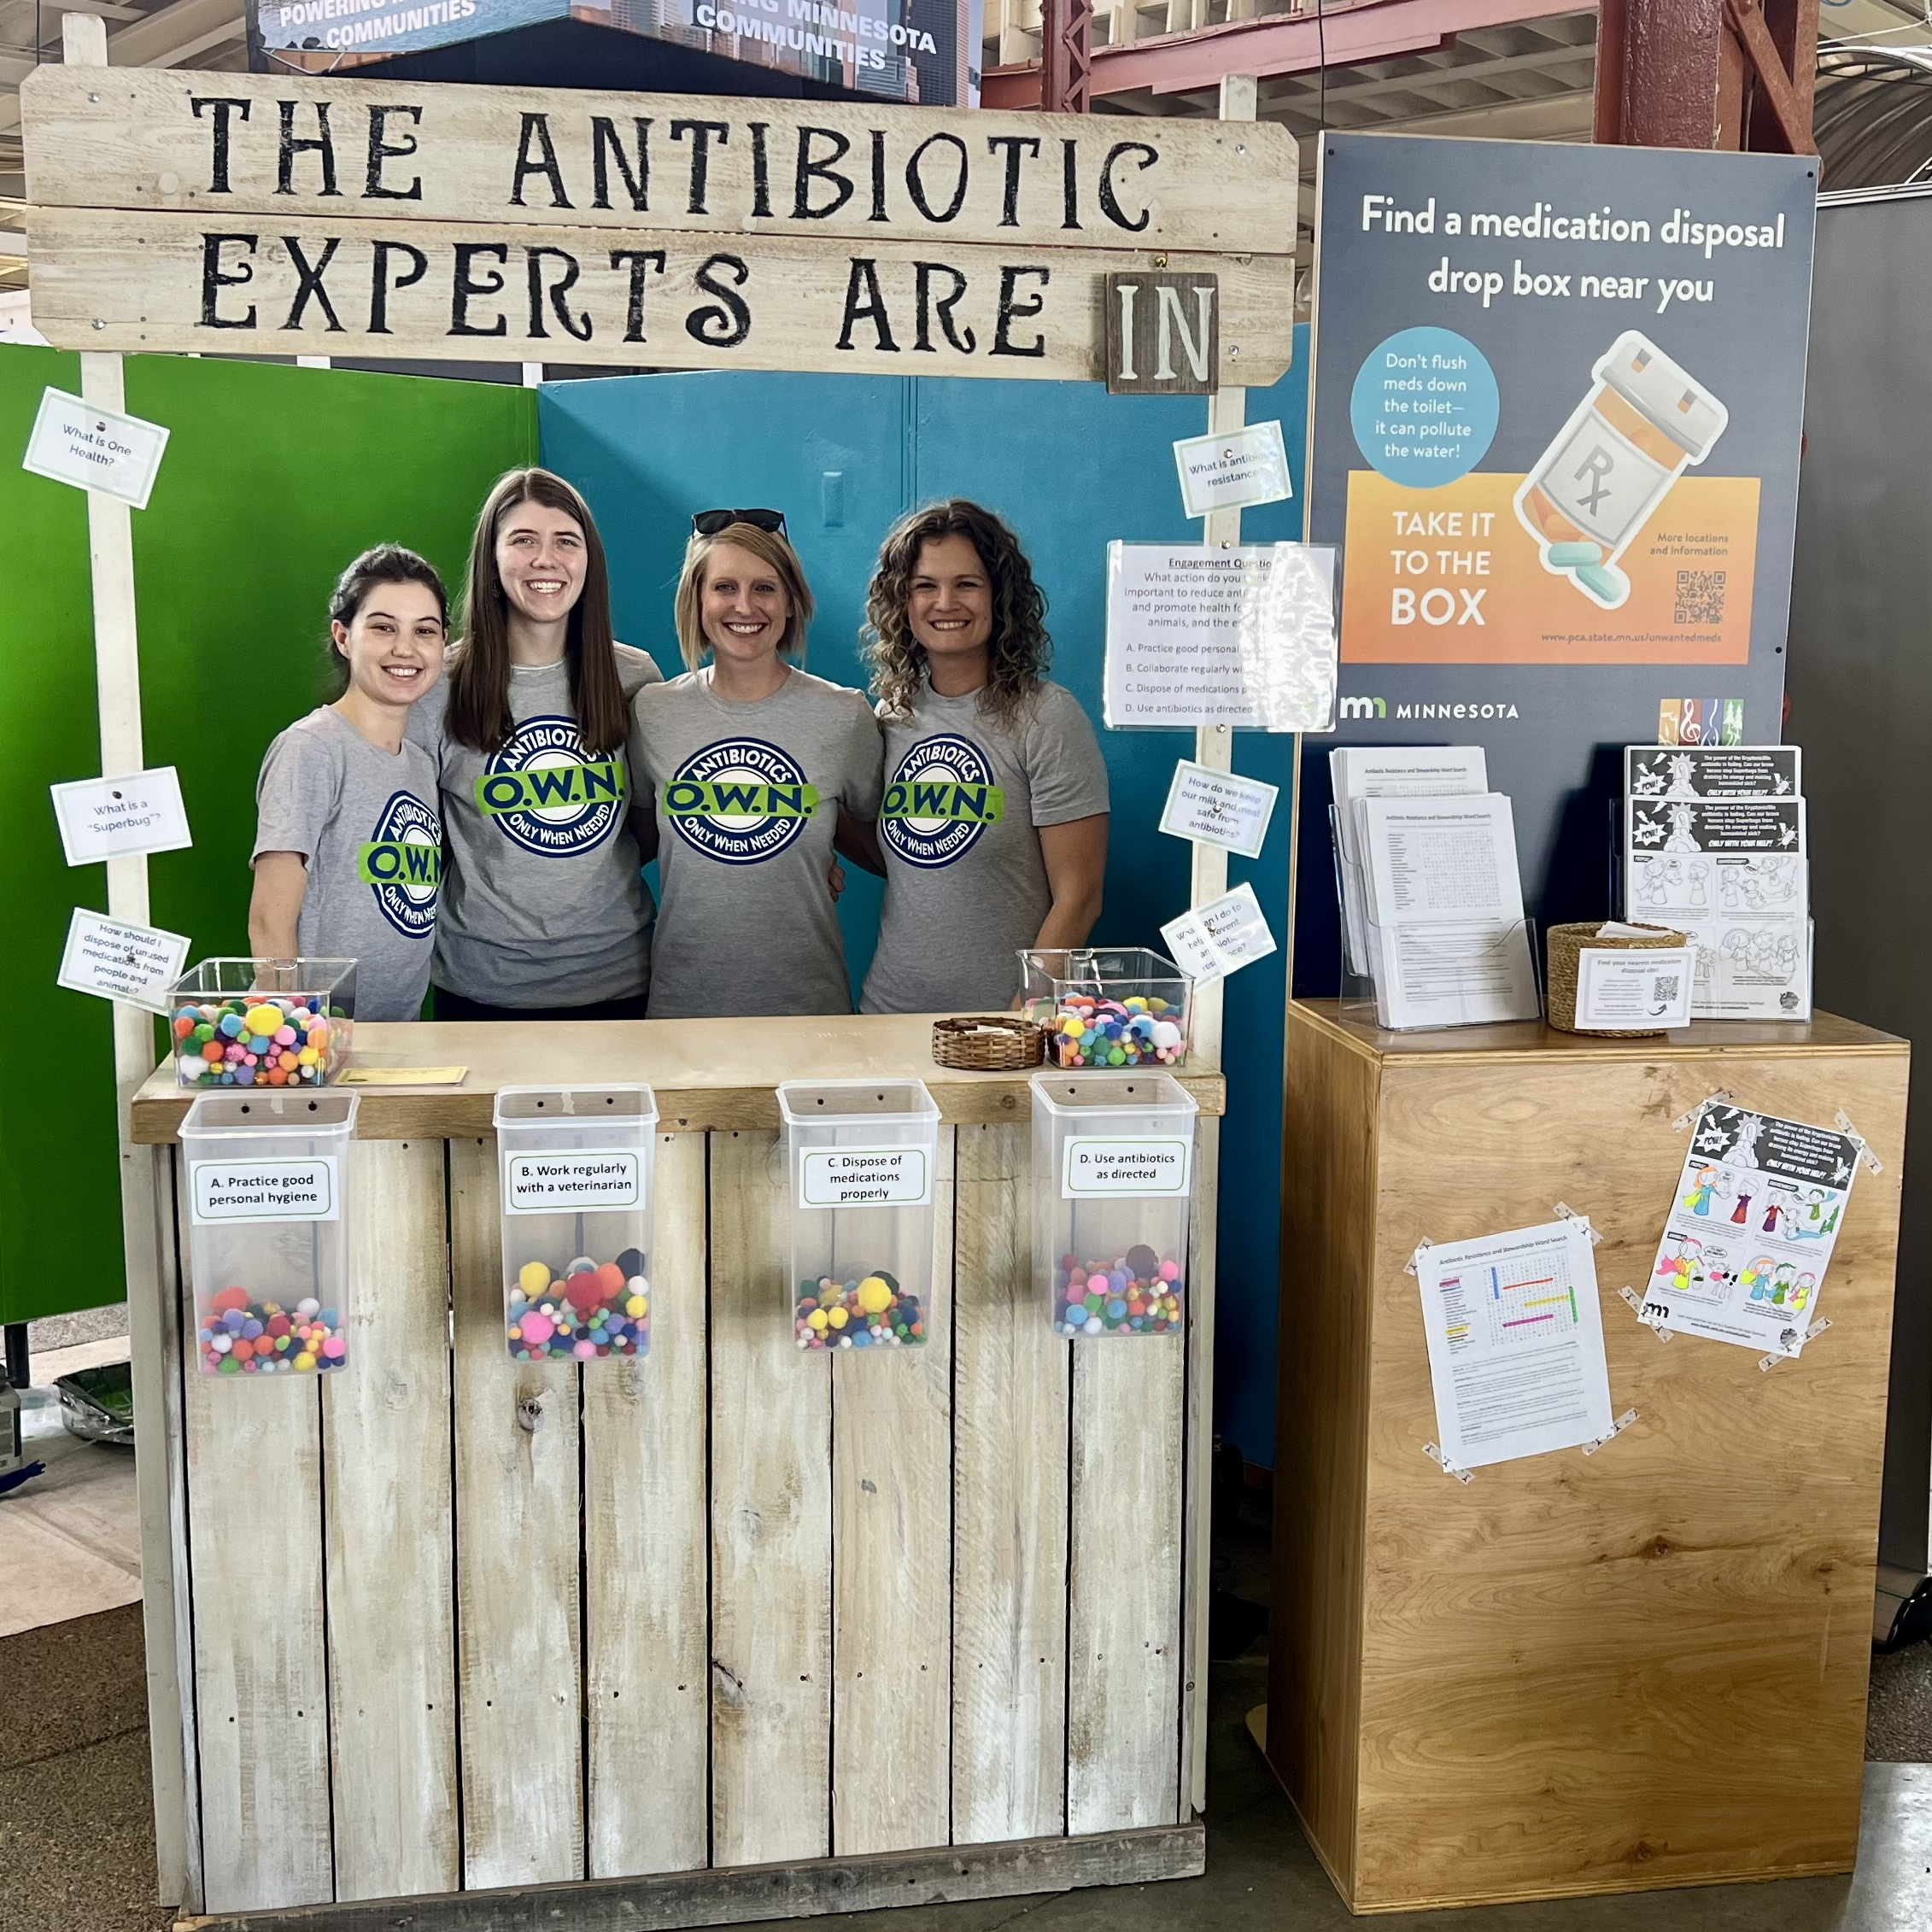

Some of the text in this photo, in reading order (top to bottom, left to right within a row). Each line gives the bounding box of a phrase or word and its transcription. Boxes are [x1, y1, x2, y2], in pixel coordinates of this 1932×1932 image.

[326, 0, 476, 49] COMMUNITIES
[787, 0, 936, 54] MINNESOTA
[696, 4, 886, 70] COMMUNITIES
[190, 97, 1159, 231] THE ANTIBIOTIC
[1362, 195, 1785, 259] Find a medication disposal
[1428, 256, 1714, 313] drop box near you
[195, 232, 1215, 381] EXPERTS ARE IN
[1386, 353, 1467, 370] Don't flush
[1384, 376, 1467, 392] meds down
[1385, 398, 1409, 413] the
[1375, 420, 1472, 439] it can pollute
[62, 424, 132, 456] What is One
[69, 444, 115, 467] Health?
[1385, 442, 1461, 458] the water!
[1189, 461, 1218, 475] What
[1219, 459, 1228, 469] is
[1392, 511, 1495, 536] TAKE IT
[1657, 532, 1729, 543] More locations
[1650, 546, 1728, 556] and information
[1168, 558, 1231, 569] Engagement
[1390, 550, 1491, 575] TO THE
[1144, 572, 1171, 583] What
[1174, 572, 1205, 583] action
[1208, 572, 1221, 583] do
[1223, 575, 1241, 585] you
[1124, 588, 1174, 599] important
[1177, 588, 1188, 598] to
[1191, 587, 1224, 598] reduce
[1132, 603, 1150, 612] and
[1153, 603, 1196, 613] promote
[1199, 602, 1231, 612] health
[1390, 588, 1487, 626] BOX
[1147, 618, 1189, 629] animals,
[1191, 618, 1210, 628] and
[1213, 618, 1230, 628] the
[1541, 632, 1722, 645] www.pca.state.mn.us/unwantedmeds
[1126, 643, 1239, 655] A. Practice good personal
[1126, 664, 1134, 673] B.
[1137, 664, 1189, 673] Collaborate
[1191, 664, 1230, 675] regularly
[1125, 683, 1134, 693] C.
[1136, 683, 1172, 694] Dispose
[1174, 683, 1184, 693] of
[1186, 684, 1239, 694] medications
[1125, 704, 1134, 712] D.
[1137, 704, 1154, 712] Use
[1156, 704, 1203, 713] antibiotics
[691, 748, 792, 783] ANTIBIOTICS
[904, 745, 980, 782] ANTIBIOTICS
[483, 765, 624, 809] O.W.N.
[1188, 777, 1262, 805] How do we keep
[666, 782, 812, 814] O.W.N.
[883, 784, 995, 820] O.W.N.
[1181, 790, 1197, 800] our
[1198, 795, 1218, 806] milk
[1219, 799, 1238, 811] and
[93, 799, 149, 816] What is a
[1197, 808, 1216, 820] safe
[509, 804, 610, 845] ONLY WHEN NEEDED
[1188, 819, 1240, 839] antibiotics?
[684, 817, 791, 852] ONLY WHEN NEEDED
[887, 819, 969, 856] ONLY WHEN NEEDED
[384, 886, 407, 915] ONLY
[403, 905, 424, 925] WHEN
[99, 923, 121, 936] How
[124, 929, 157, 946] should
[84, 934, 121, 951] dispose
[123, 944, 133, 955] of
[94, 964, 148, 985] people and
[143, 962, 164, 976] from
[97, 980, 139, 995] animals?
[828, 1155, 903, 1168] C. Dispose of
[1080, 1153, 1175, 1163] D. Use antibiotics
[522, 1162, 627, 1177] B. Work regularly
[830, 1173, 899, 1183] medications
[1097, 1168, 1156, 1180] as directed
[210, 1174, 313, 1188] A. Practice good
[516, 1181, 544, 1193] with
[558, 1180, 632, 1191] veterinarian
[208, 1191, 318, 1207] personal hygiene
[840, 1188, 889, 1201] properly
